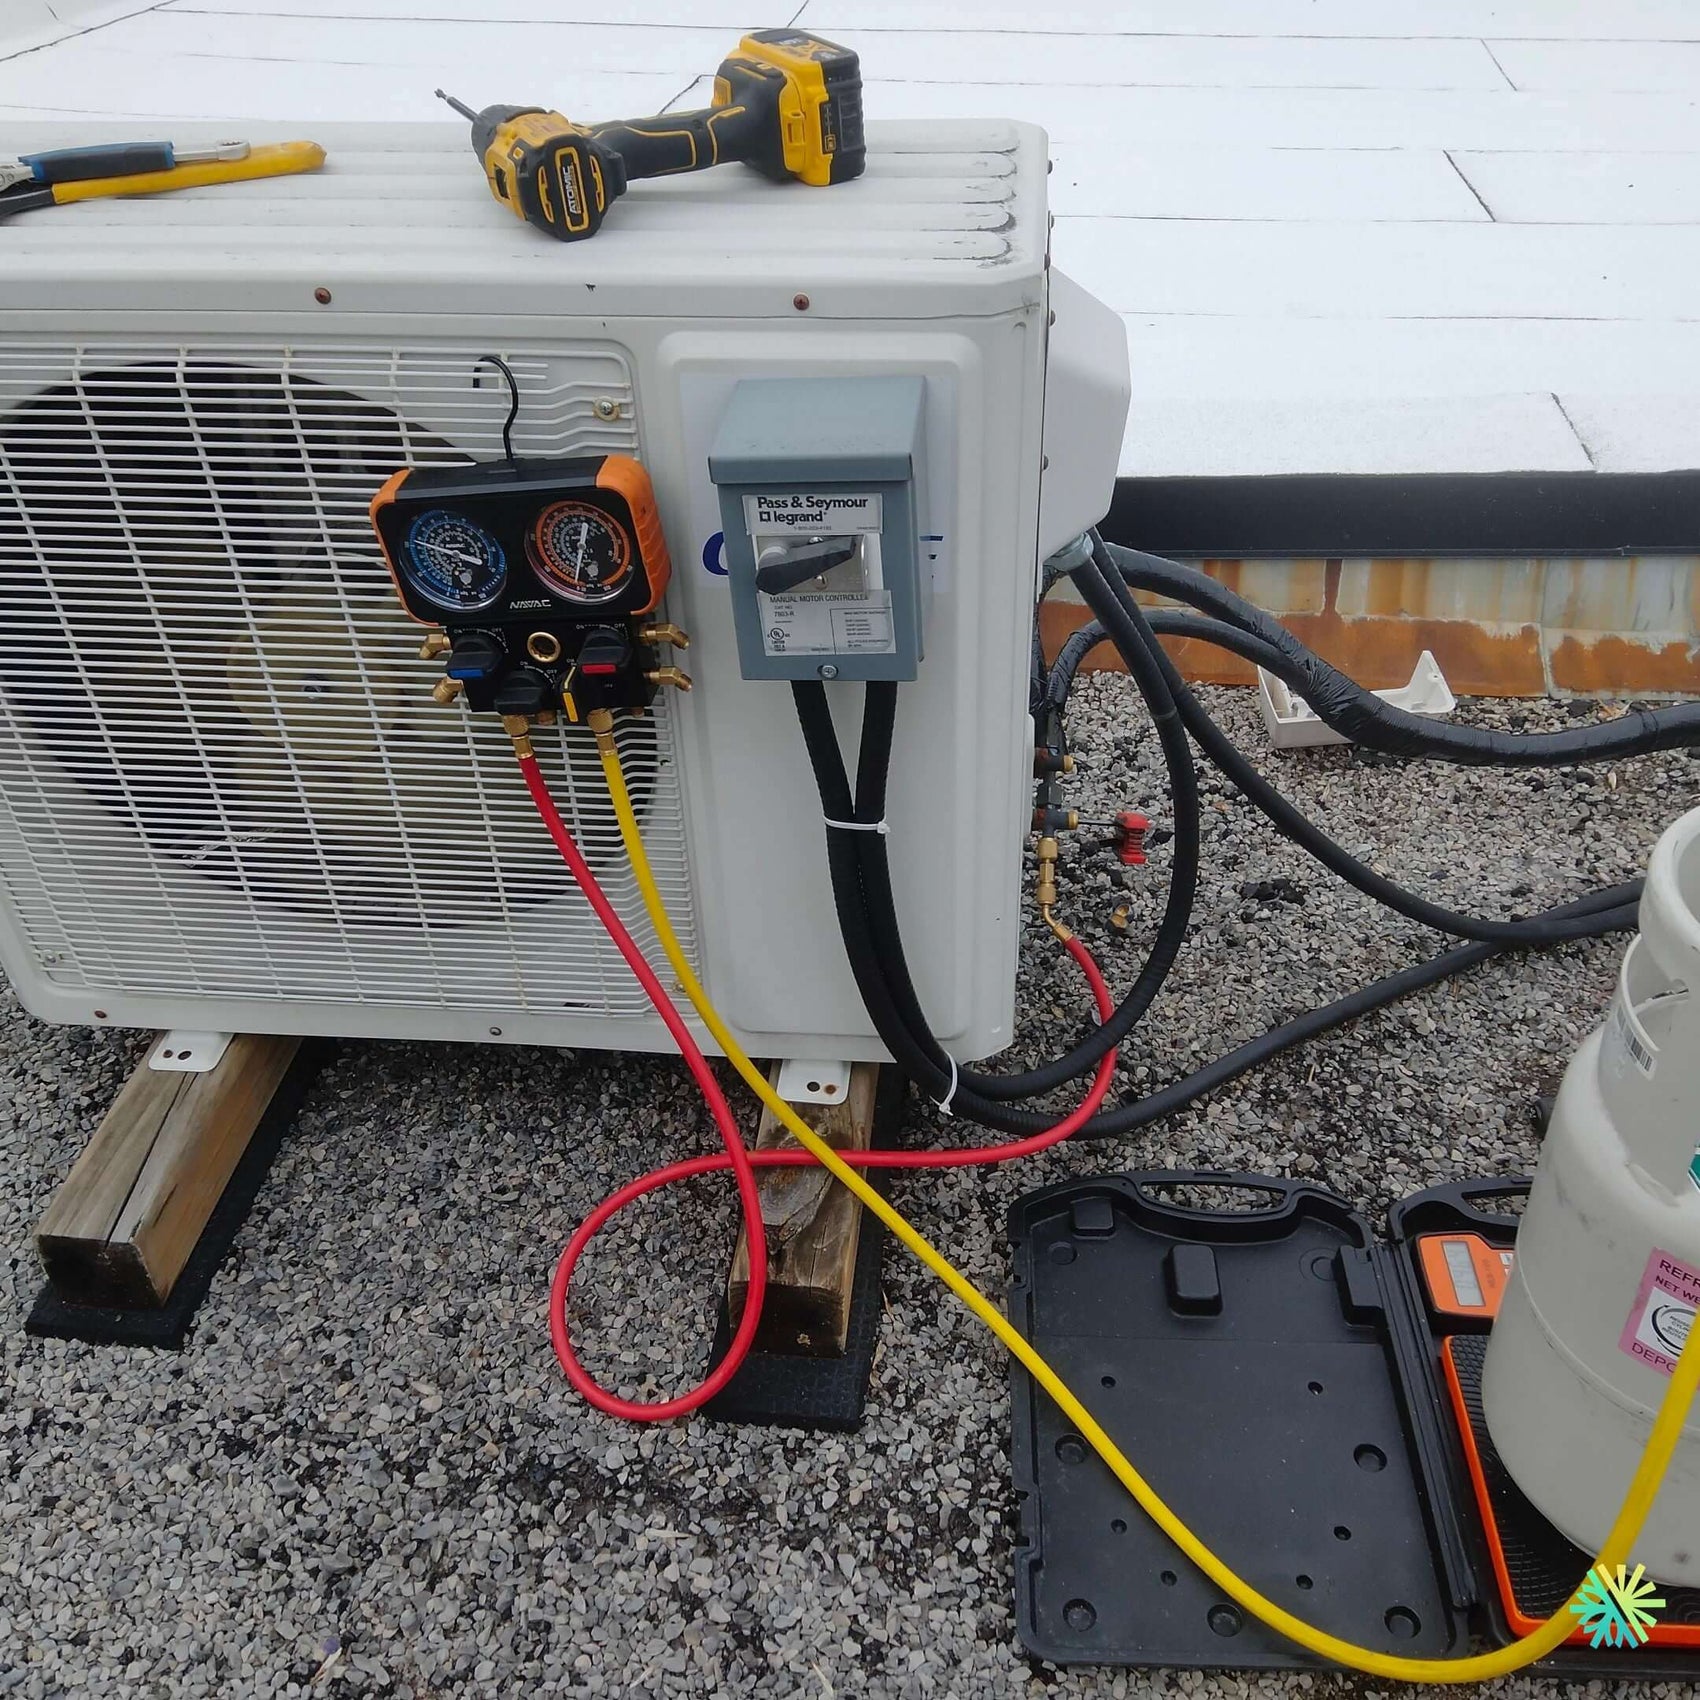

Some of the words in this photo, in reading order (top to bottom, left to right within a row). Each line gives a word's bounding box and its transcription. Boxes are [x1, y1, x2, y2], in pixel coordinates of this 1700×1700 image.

[562, 165, 577, 214] ATOMIC
[757, 496, 789, 509] Pass
[791, 496, 803, 509] &
[806, 496, 869, 511] Seymour
[773, 510, 823, 525] legrand
[509, 599, 552, 610] NAVAC
[1655, 1275, 1680, 1292] NET
